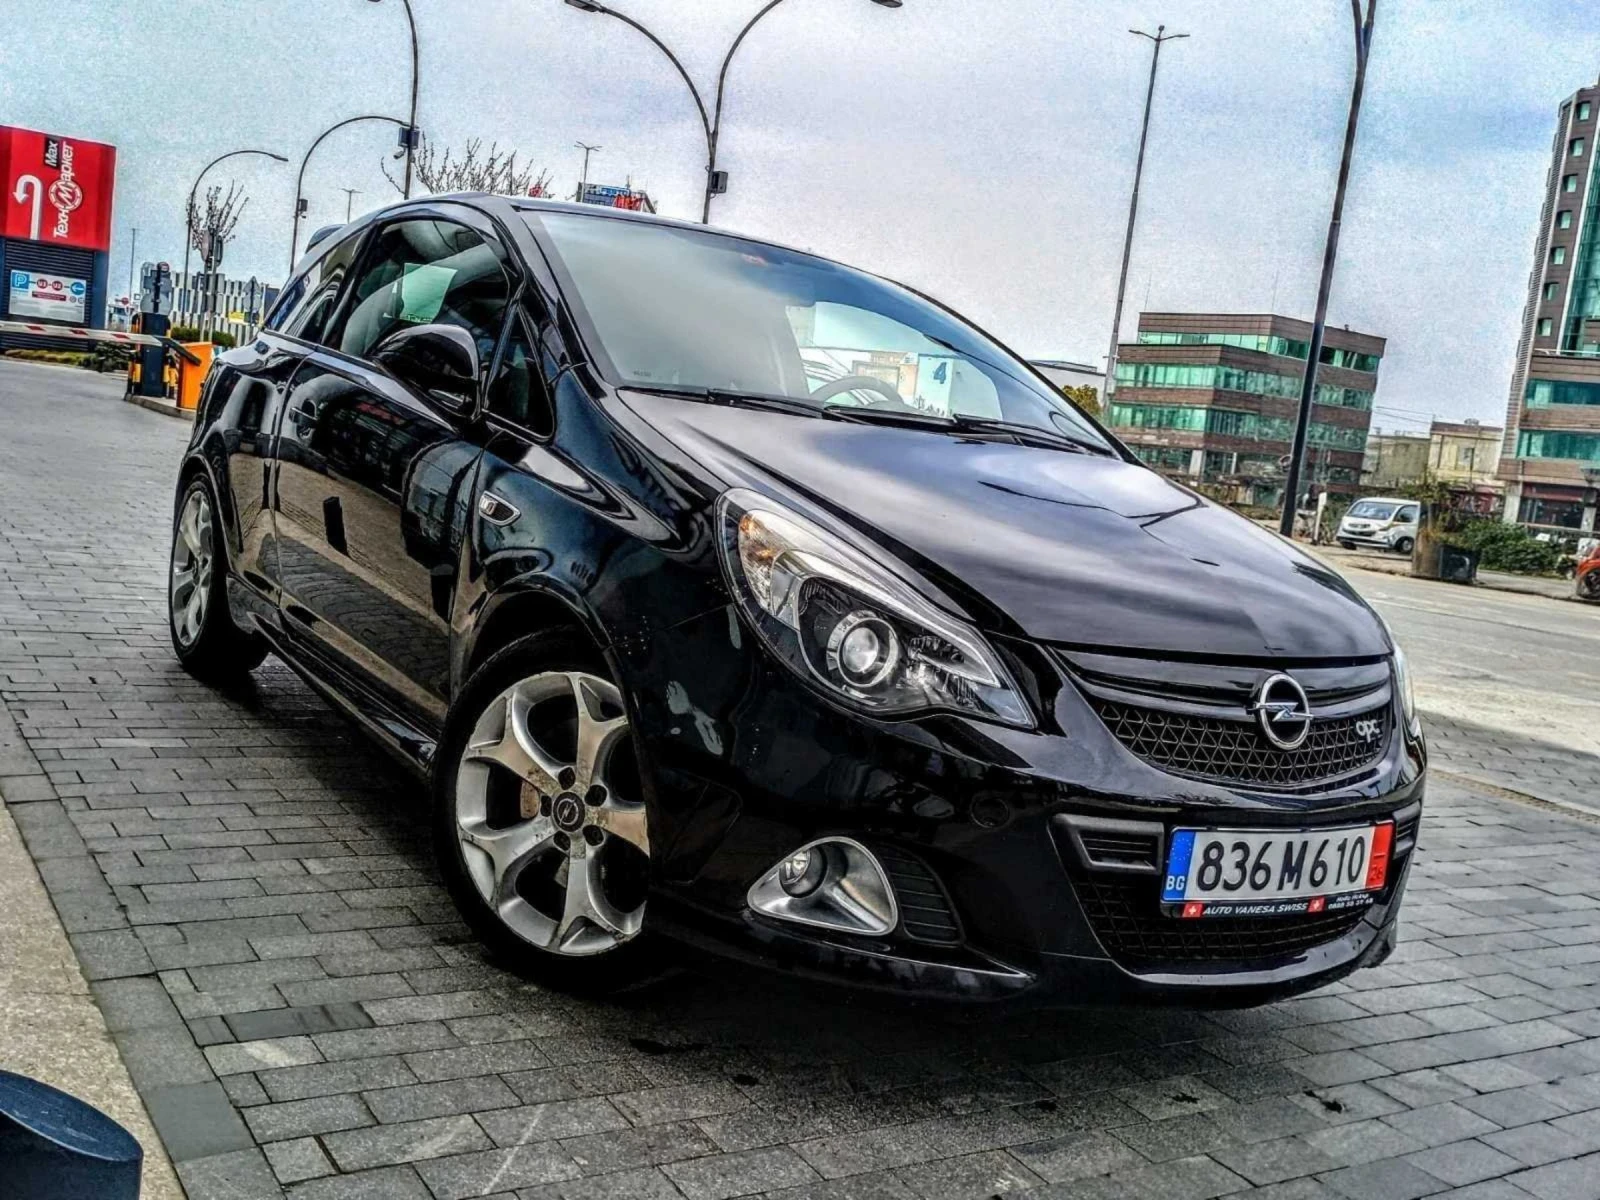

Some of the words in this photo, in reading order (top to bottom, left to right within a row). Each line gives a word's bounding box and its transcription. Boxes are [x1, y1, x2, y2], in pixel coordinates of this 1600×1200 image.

[45, 141, 58, 167] Max
[933, 361, 947, 385] 4
[1165, 875, 1186, 891] BG
[1202, 906, 1233, 916] AUTO
[1235, 905, 1276, 914] VANESA
[1276, 902, 1309, 913] SWISS
